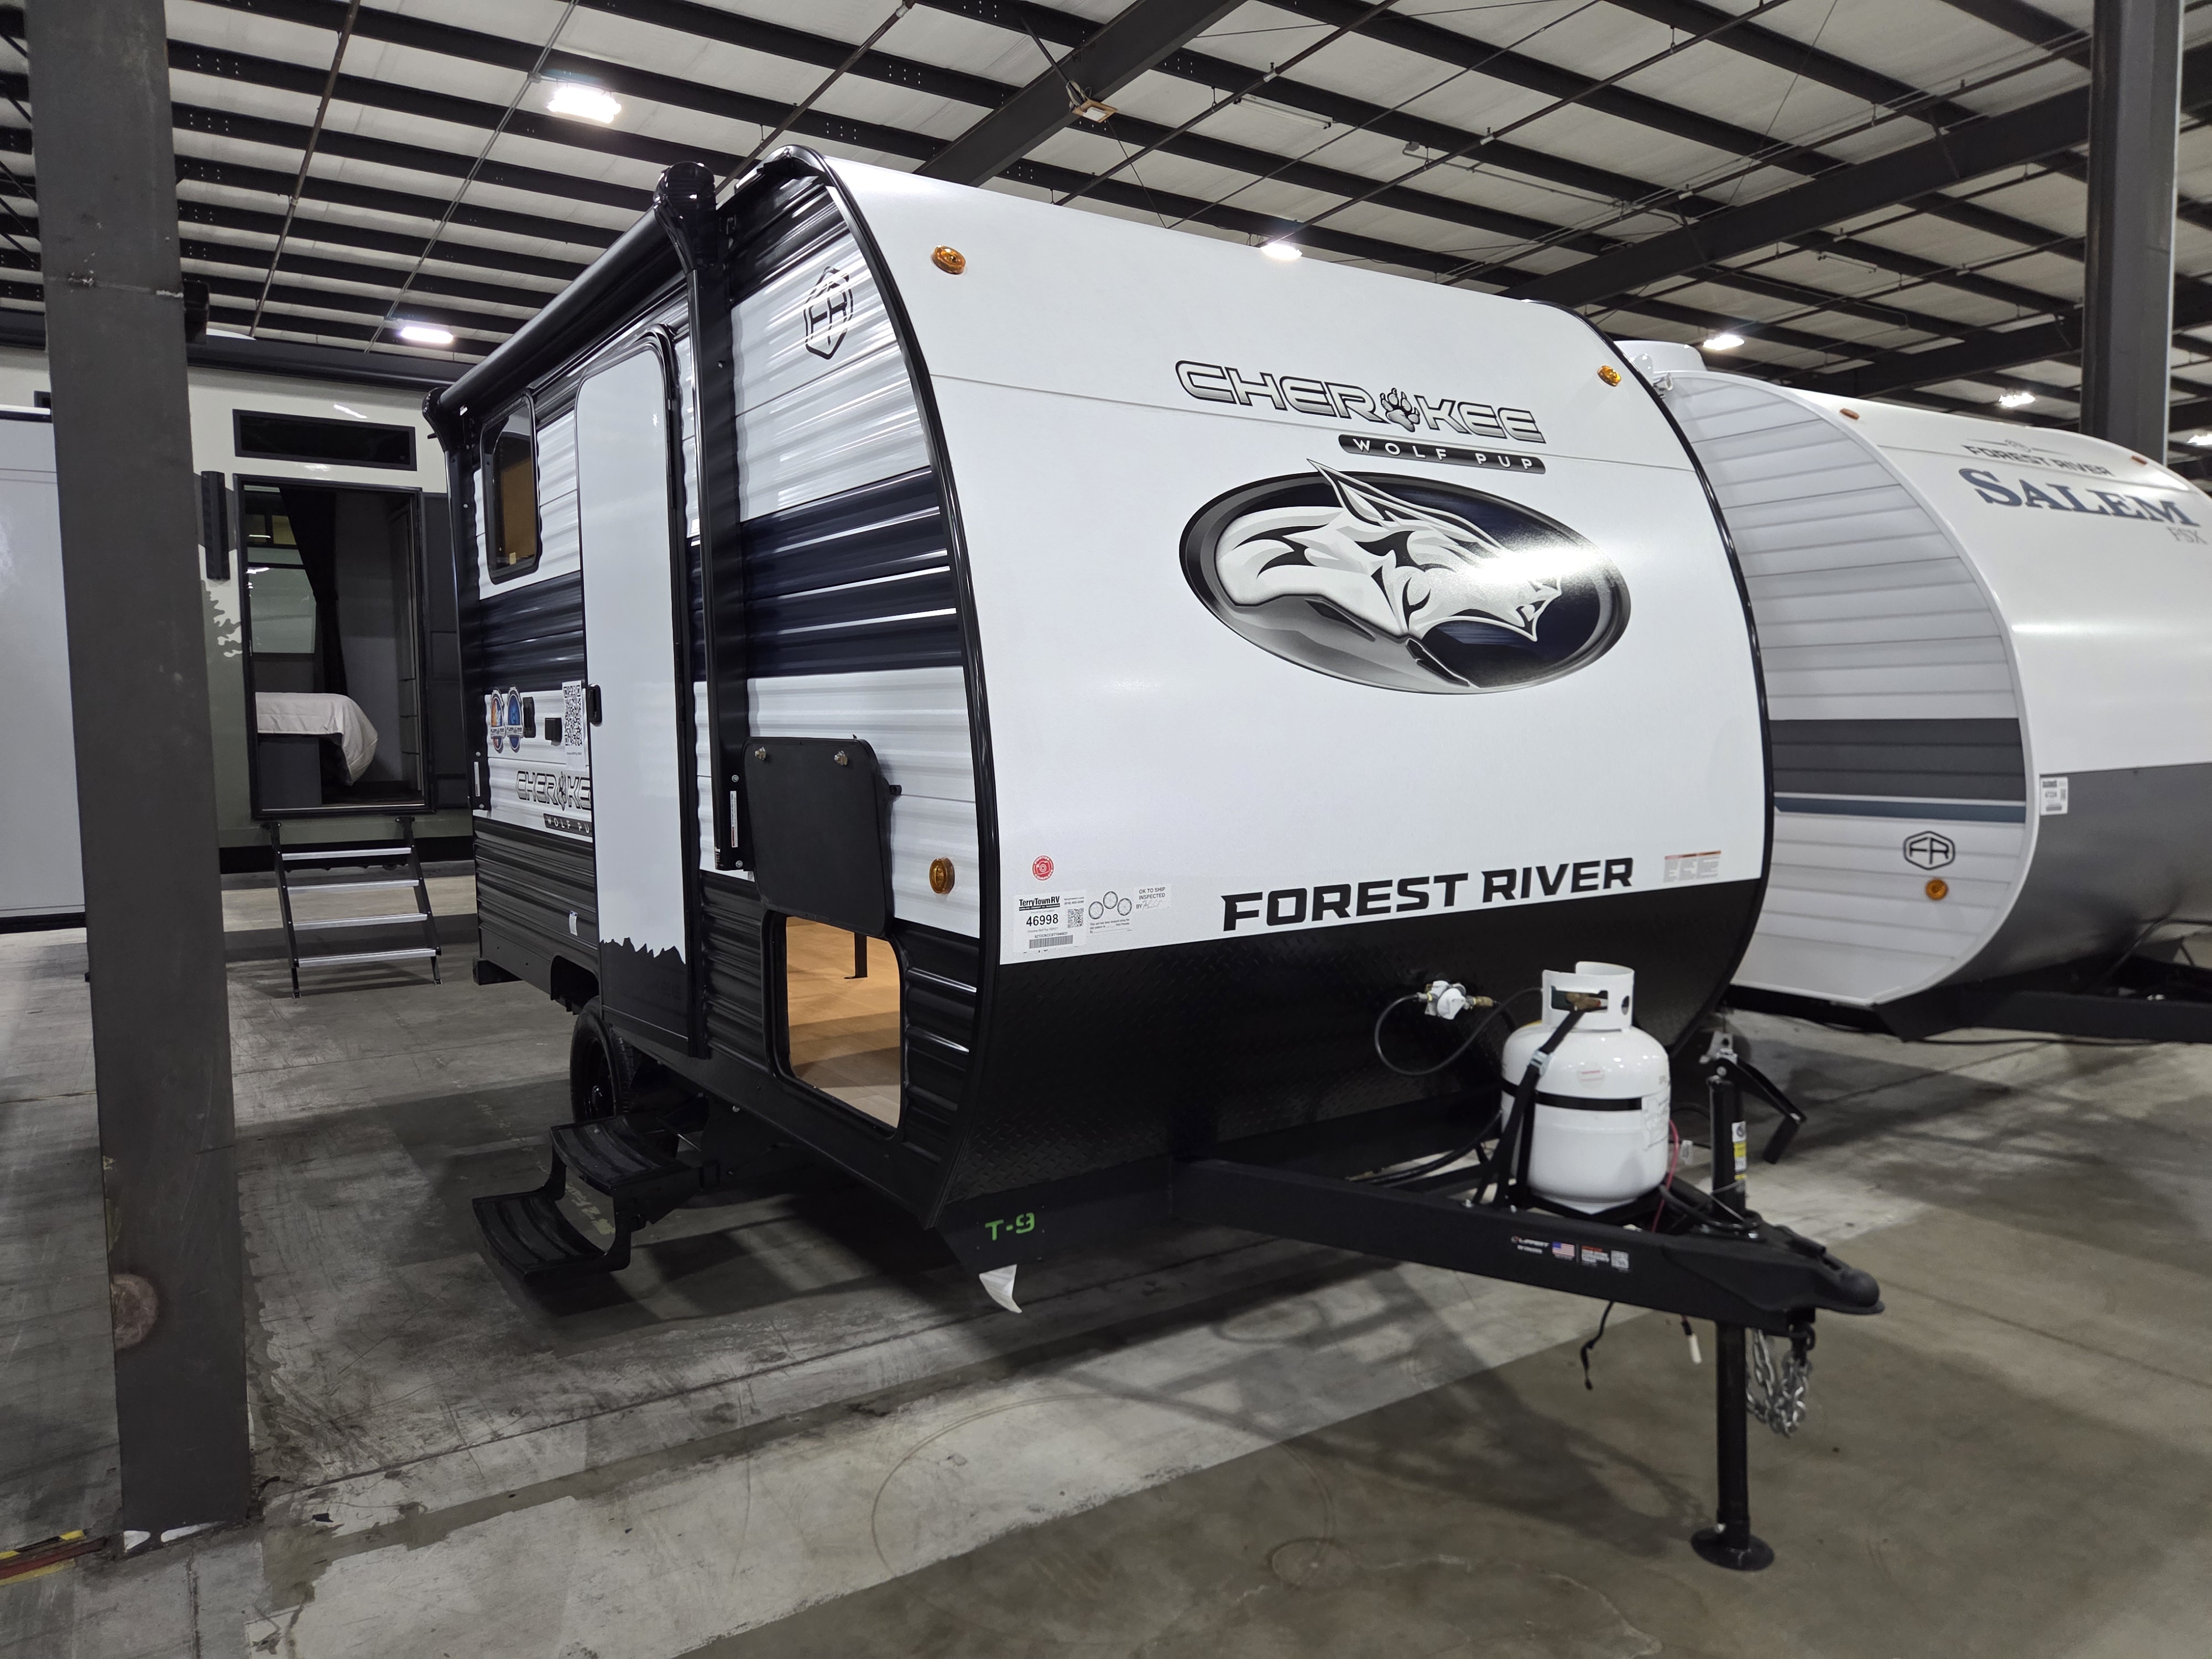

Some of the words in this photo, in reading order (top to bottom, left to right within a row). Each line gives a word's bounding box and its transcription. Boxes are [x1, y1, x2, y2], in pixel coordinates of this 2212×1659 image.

[1353, 438, 1447, 460] WOLF
[1475, 452, 1533, 470] PUP
[1961, 445, 2052, 466] FOREST
[2052, 458, 2115, 477] RIVER
[1959, 468, 2200, 527] SALEM
[546, 815, 571, 830] WOLF
[577, 822, 590, 834] PU
[1220, 873, 1469, 932] FOREST
[1481, 857, 1633, 904] RIVER
[1026, 914, 1058, 926] 46998
[985, 1212, 1035, 1240] T-9
